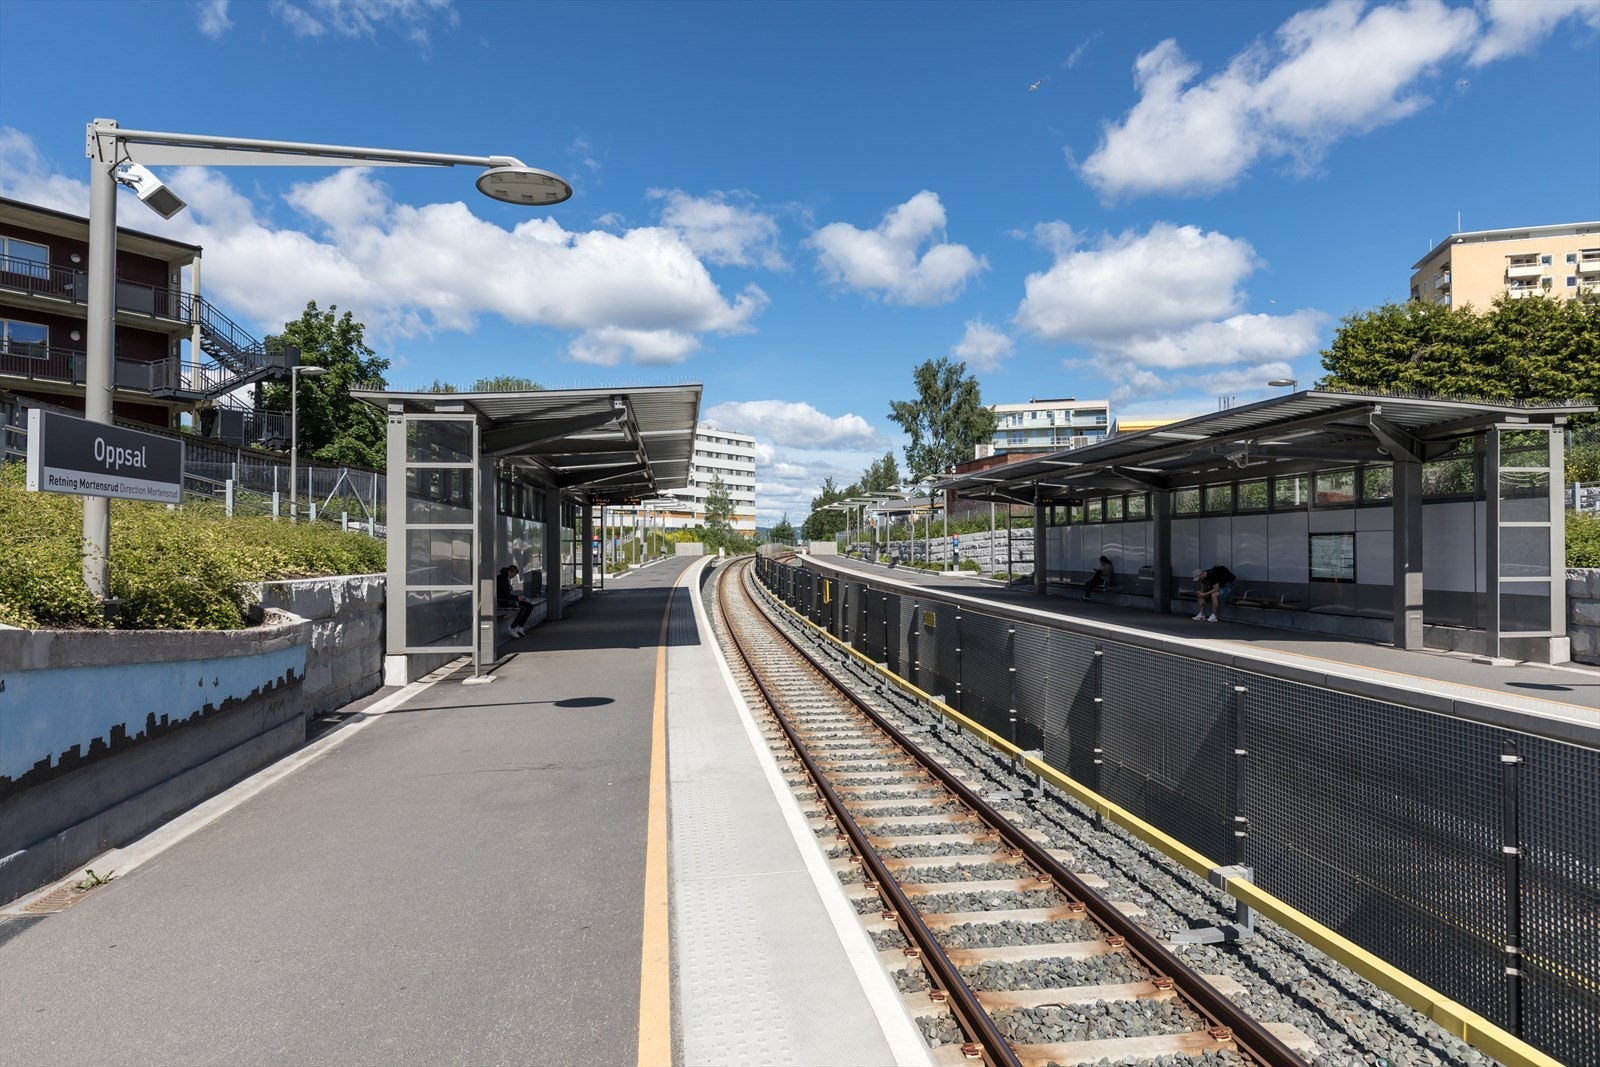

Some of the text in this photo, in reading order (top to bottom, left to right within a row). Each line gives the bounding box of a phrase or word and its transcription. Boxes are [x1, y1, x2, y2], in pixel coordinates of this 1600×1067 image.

[94, 437, 147, 470] Oppsal
[49, 475, 178, 499] Retning Mortensrud Direction Mortensrud
